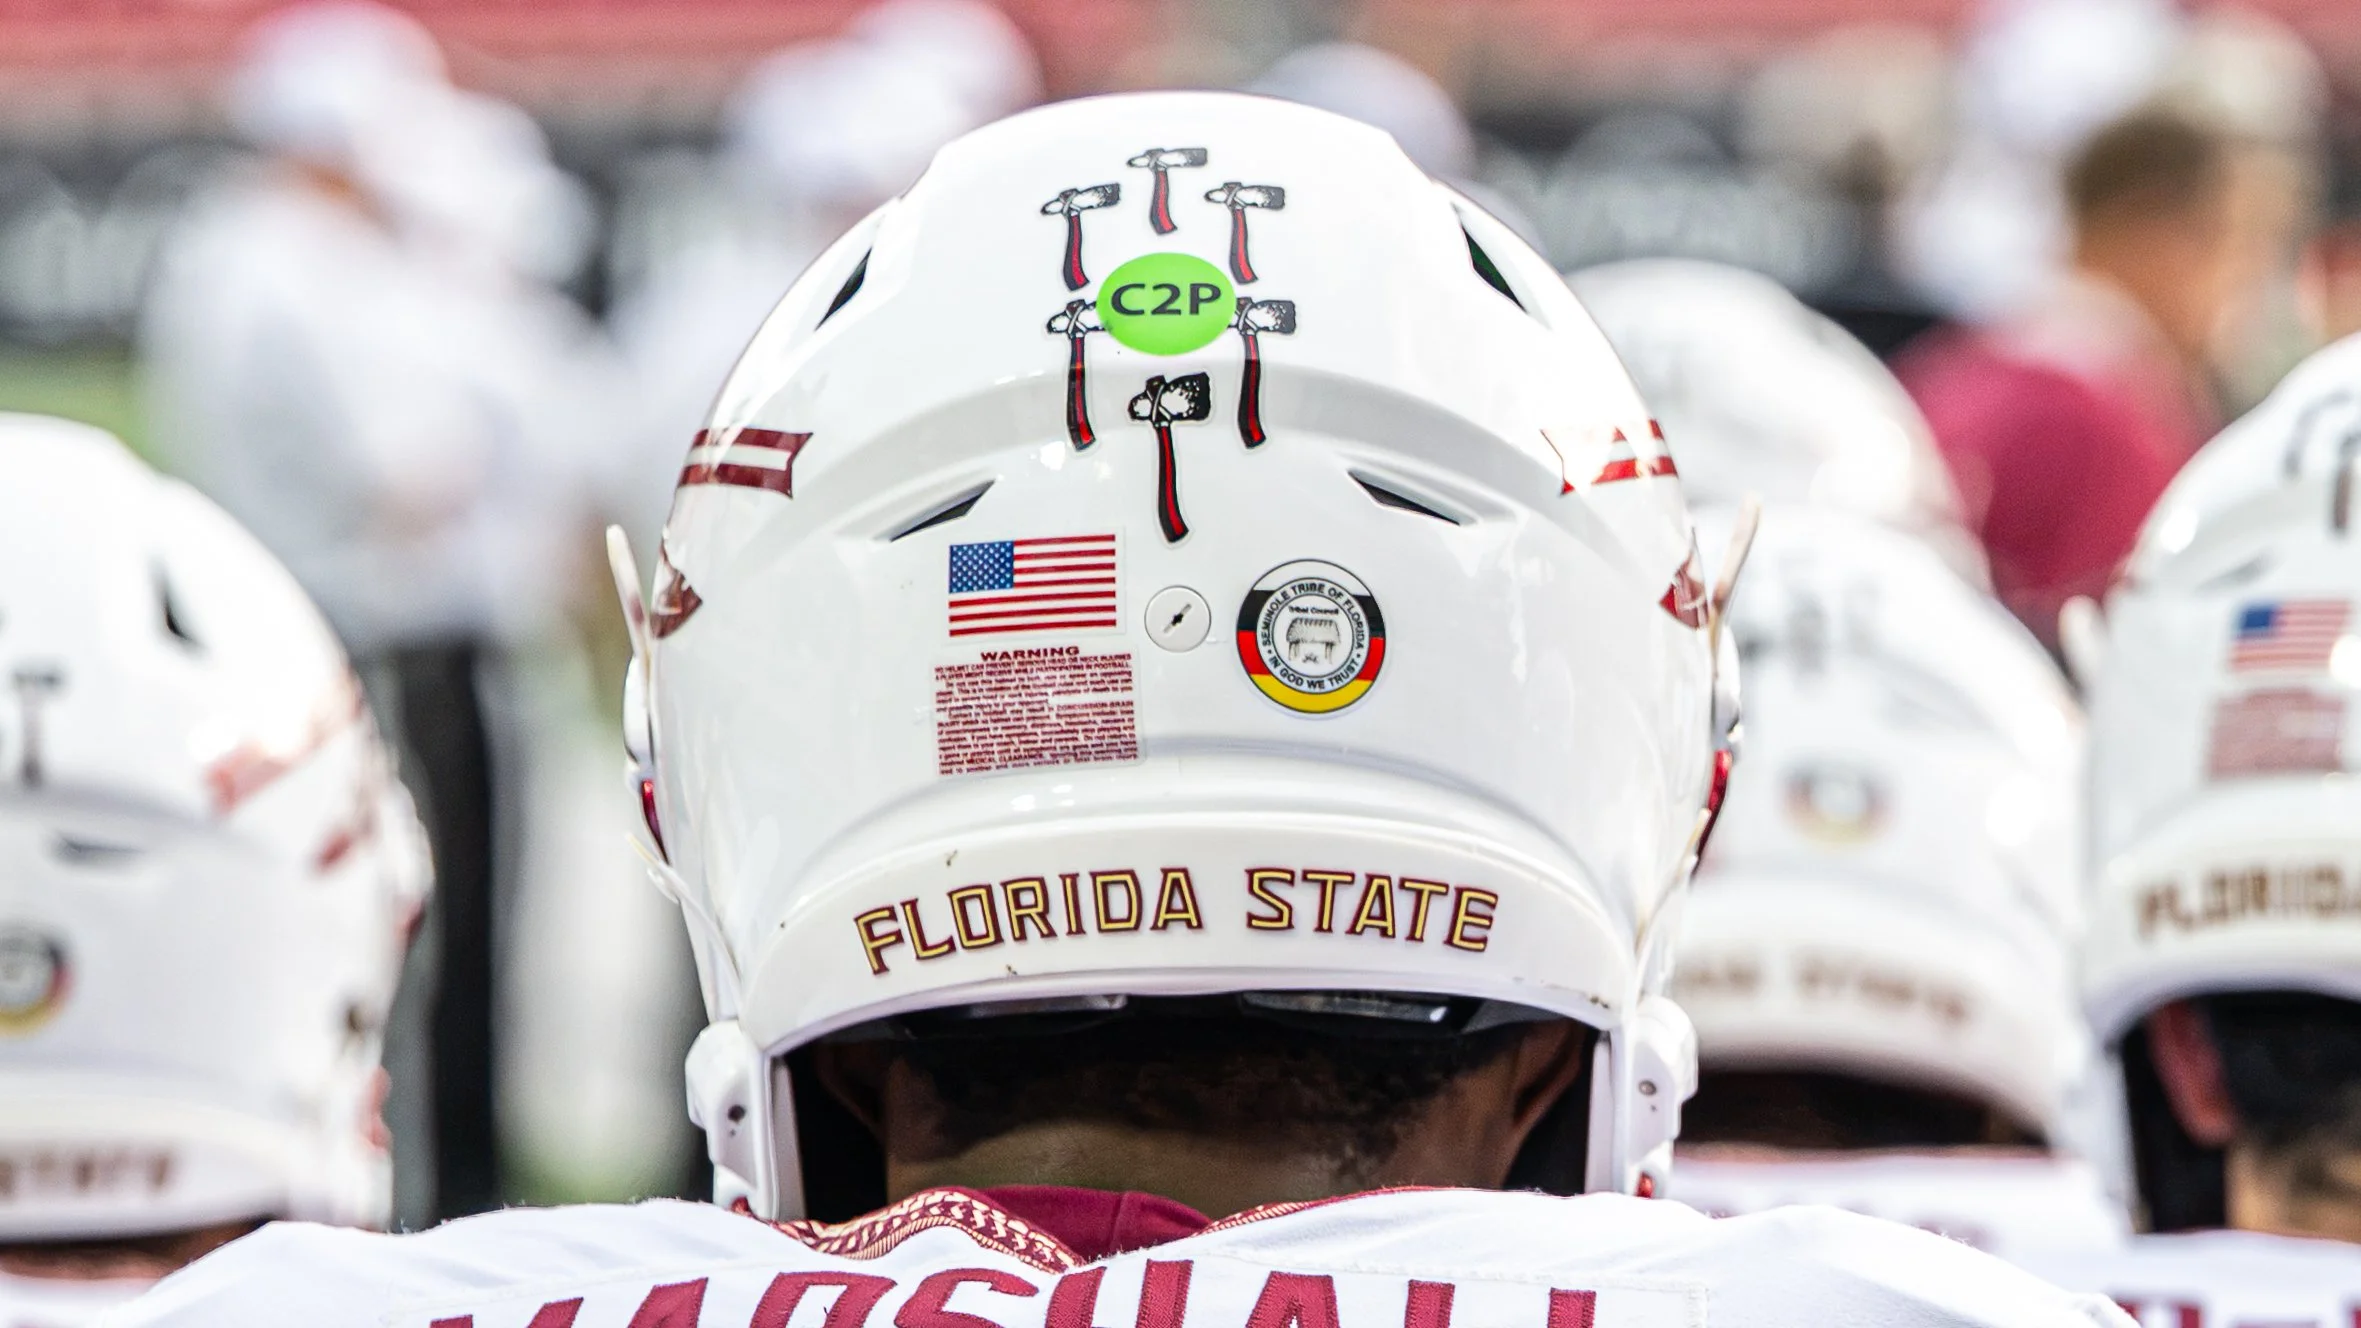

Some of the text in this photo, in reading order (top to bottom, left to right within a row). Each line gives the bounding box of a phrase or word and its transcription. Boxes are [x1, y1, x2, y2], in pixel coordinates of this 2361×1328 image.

[1110, 283, 1222, 316] C2P
[1261, 582, 1365, 649] SEMINOLE TRIBE OF FLORIDA
[1288, 606, 1339, 615] Tribal Council
[980, 646, 1080, 662] WARNING
[1268, 655, 1360, 690] IN GOD WE TRUST
[852, 867, 1499, 975] FLORIDA STATE
